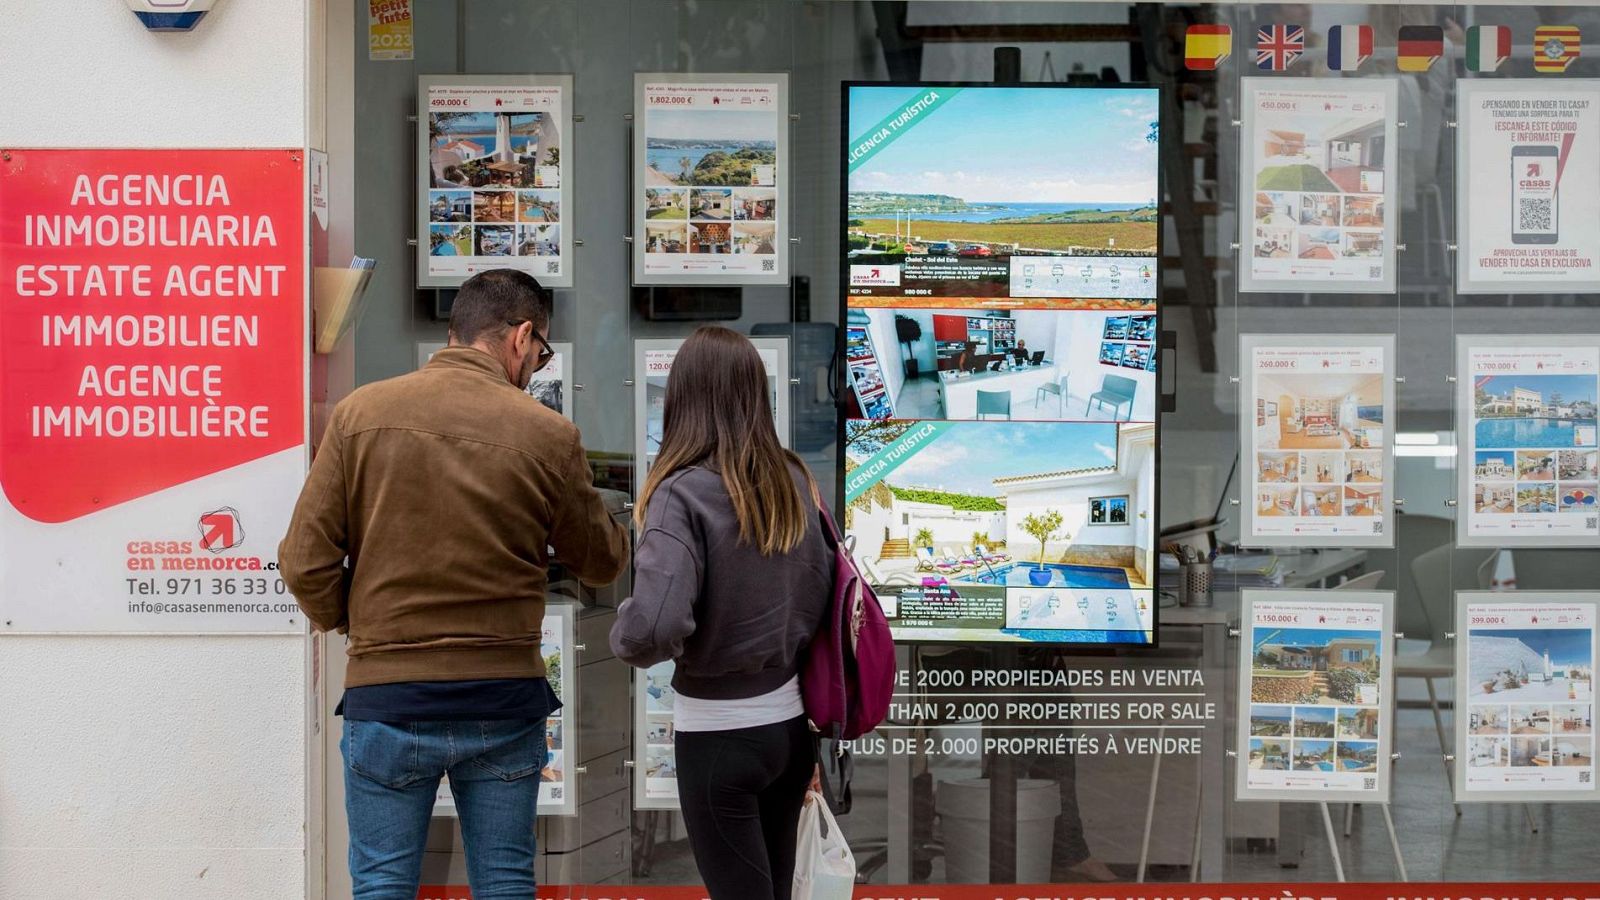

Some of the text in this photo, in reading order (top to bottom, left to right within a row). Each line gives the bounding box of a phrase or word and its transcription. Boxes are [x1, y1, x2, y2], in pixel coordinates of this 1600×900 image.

[378, 10, 410, 24] futé
[370, 34, 411, 47] 2023
[431, 98, 468, 106] 490.000 €
[650, 96, 692, 104] 1.802.000 €
[1261, 101, 1290, 109] 450.000
[1482, 100, 1589, 109] ¿PENSANDO EN VENDER TU CASA?
[1492, 110, 1579, 118] TENEMOS UNA SORPRESA PARA TI
[848, 91, 940, 164] LICENCIA TURÍSTICA
[1494, 121, 1577, 132] ¡ESCANEA ESTE CÓDIGO
[1511, 132, 1516, 142] E
[70, 174, 231, 207] AGENCIA
[24, 214, 278, 247] INMOBILIARIA
[1493, 249, 1577, 257] APROVECHA LAS VENTAJAS DE
[1480, 258, 1591, 268] VENDER TU CASA EN EXCLUSIVA
[16, 265, 287, 297] ESTATE AGENT
[42, 315, 259, 347] IMMOBILIEN
[77, 365, 223, 397] AGENCE
[32, 398, 269, 437] IMMOBILIÈRE
[845, 423, 936, 494] LICENCIA TURÍSTICA
[126, 540, 193, 554] casas
[126, 557, 158, 571] en
[126, 578, 286, 595] Tel. 971 36 33 0
[128, 600, 299, 614] info@casasenmenorca.com
[1256, 614, 1298, 622] 1.150.000 €
[917, 669, 965, 687] 2000
[971, 669, 1104, 687] PROPIEDADES
[1110, 669, 1136, 687] EN
[1142, 669, 1205, 687] VENTA
[889, 703, 1216, 720] THAN 2.000 PROPERTIES FOR SALE
[893, 738, 917, 755] DE
[924, 738, 977, 755] 2.000
[984, 734, 1099, 755] PROPRIÉTÉS
[1105, 733, 1118, 755] À
[1124, 738, 1202, 755] VENDRE
